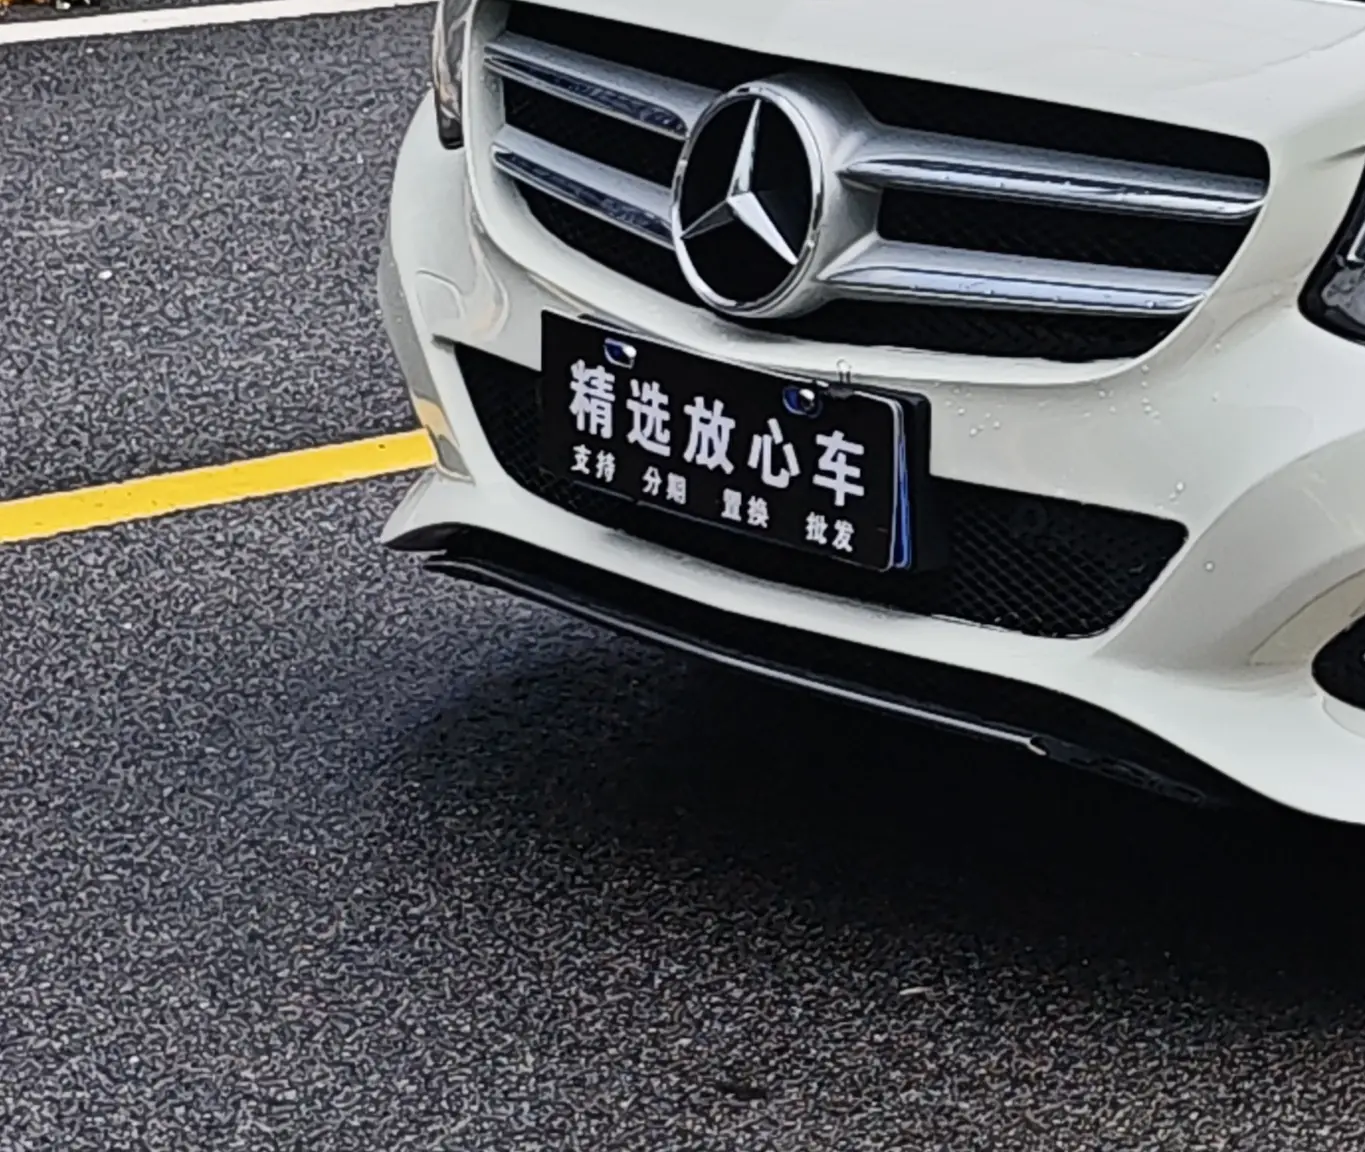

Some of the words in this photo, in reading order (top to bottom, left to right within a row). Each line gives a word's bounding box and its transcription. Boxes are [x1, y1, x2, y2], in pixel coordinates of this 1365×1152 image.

[569, 359, 865, 507] 精选放心车
[570, 444, 617, 483] 支持
[641, 466, 688, 506] 分期
[720, 488, 770, 529] 置换
[804, 511, 857, 553] 批发
